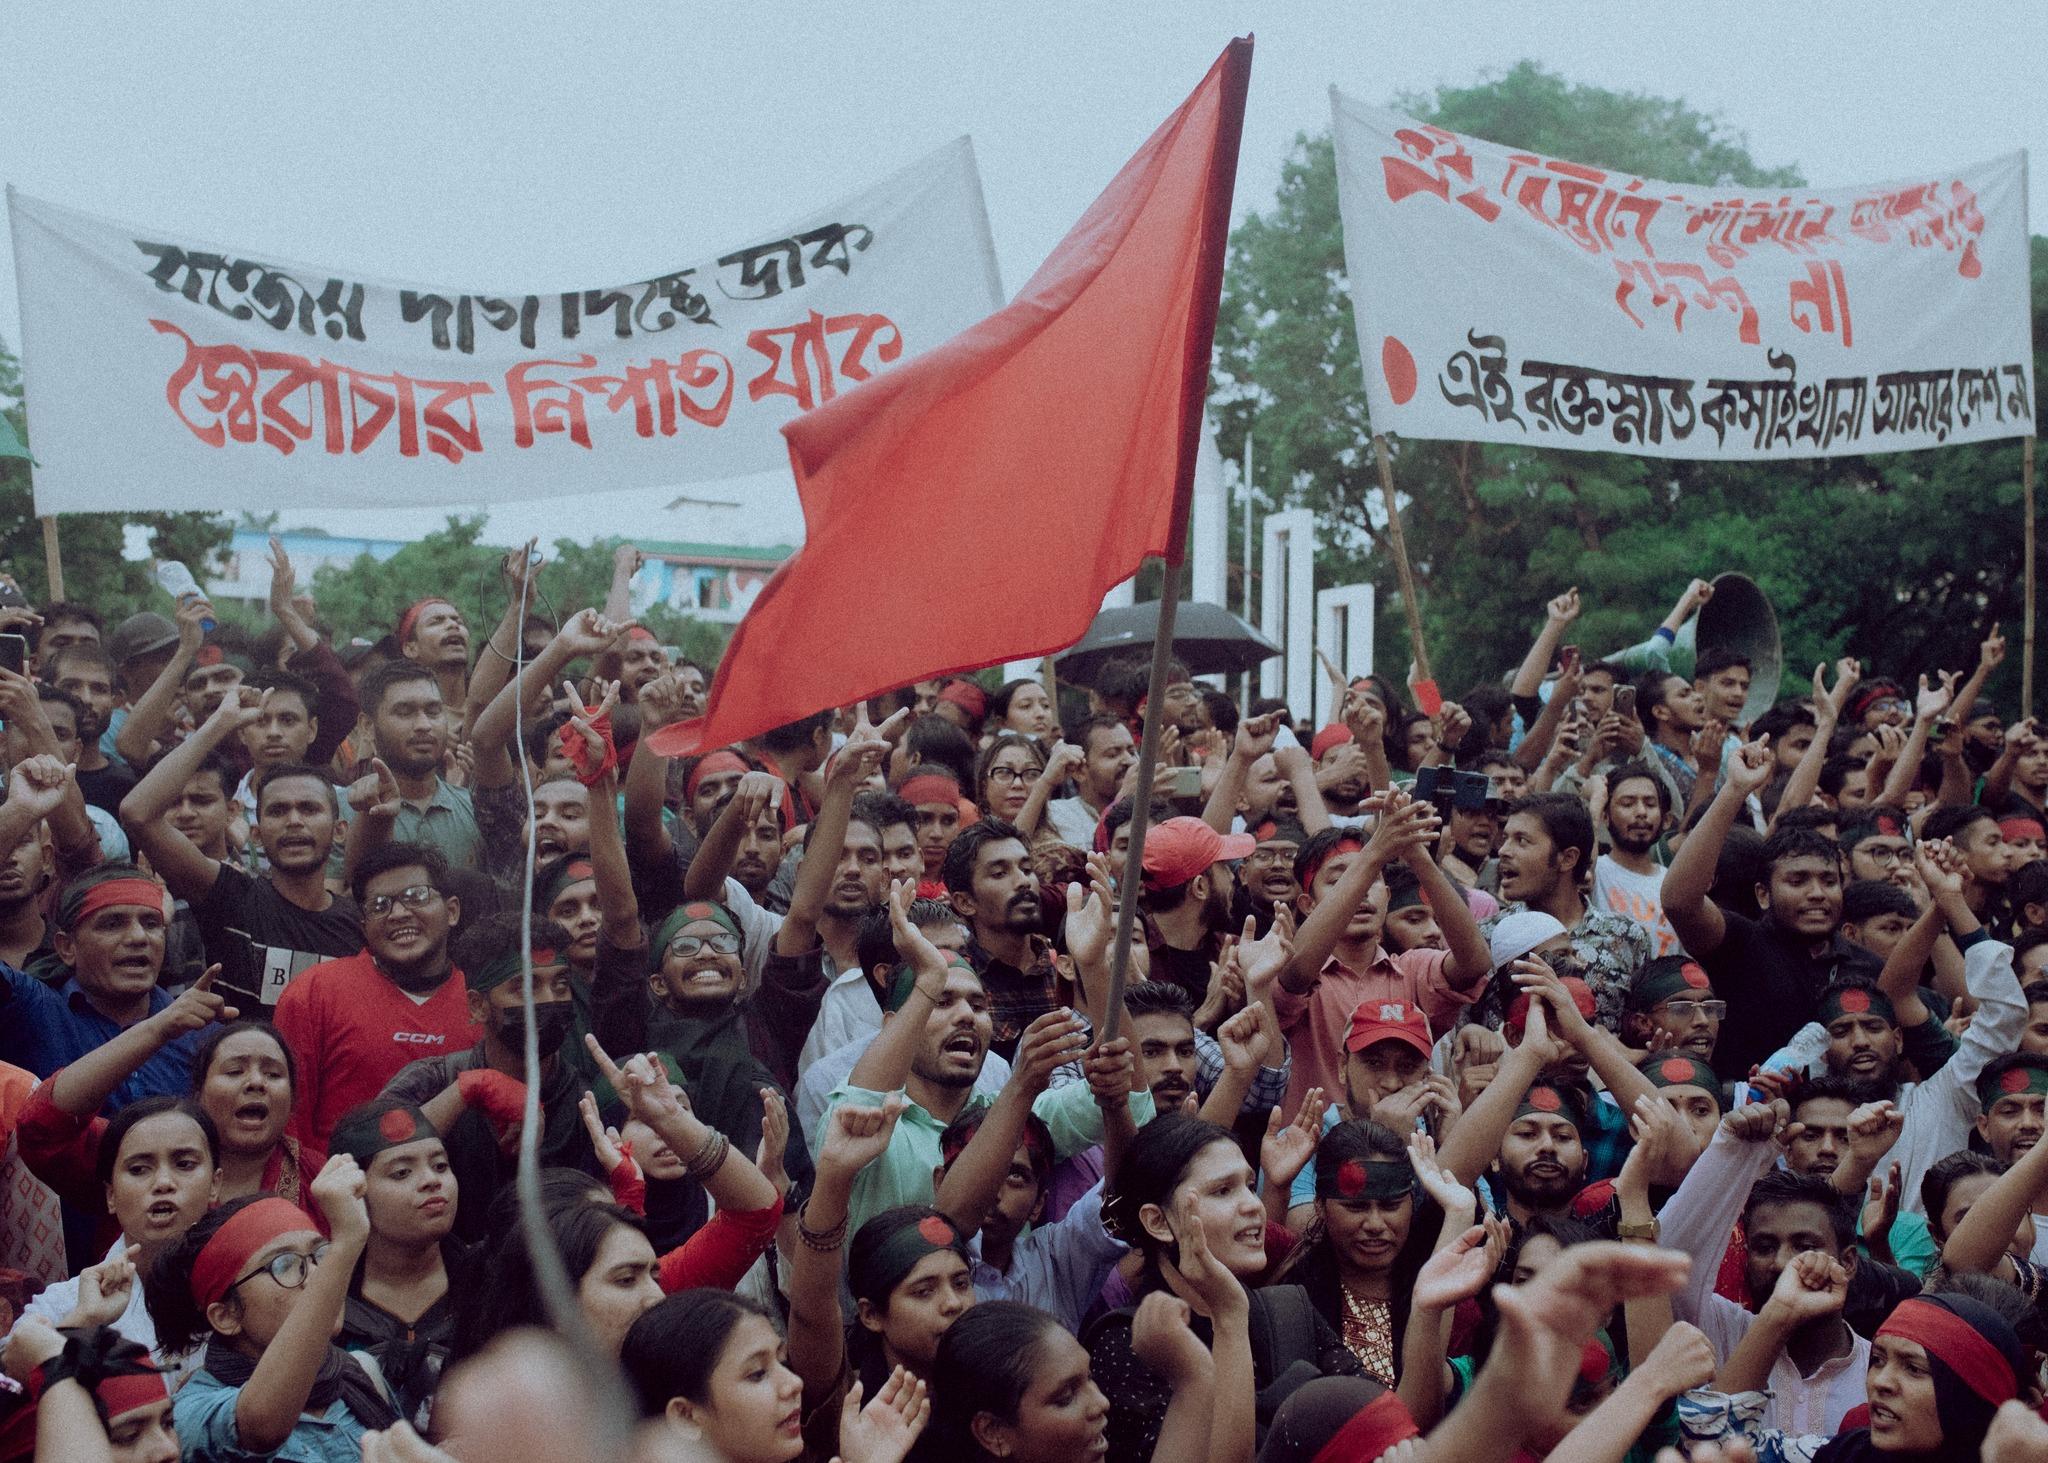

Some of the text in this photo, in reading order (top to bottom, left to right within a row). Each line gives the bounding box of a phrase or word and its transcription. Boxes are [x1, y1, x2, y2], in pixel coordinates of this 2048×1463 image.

[399, 289, 540, 355] দাগ
[716, 222, 875, 300] ডাক
[1788, 258, 1853, 348] না
[148, 308, 905, 465] স্বৈরাচার নিপাত যাক
[1437, 326, 1528, 434] এই
[1700, 347, 1869, 451] কসাইখানা
[1872, 368, 1956, 443] আমার
[1956, 366, 2006, 428] দেশ
[270, 967, 286, 985] B
[1379, 1003, 1405, 1023] N
[392, 1031, 446, 1045] CCM
